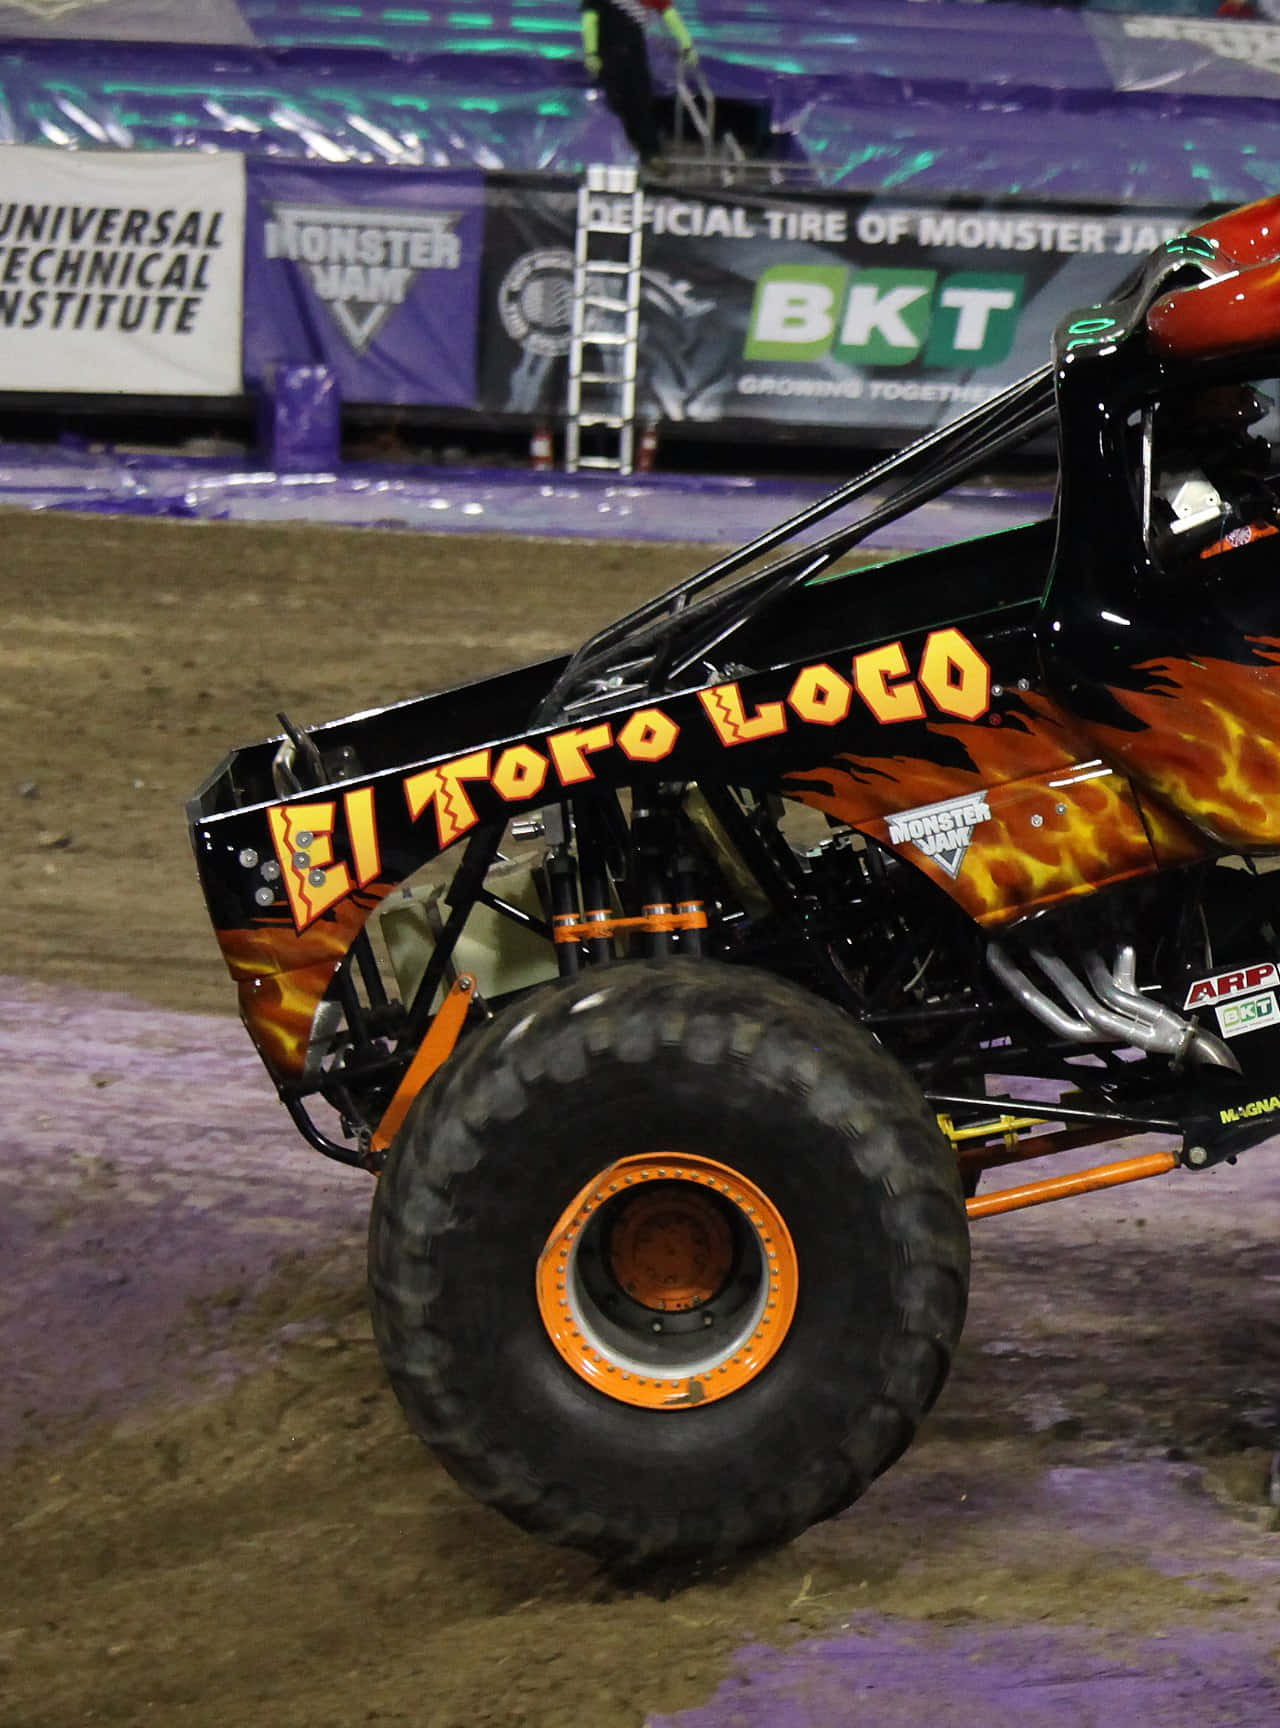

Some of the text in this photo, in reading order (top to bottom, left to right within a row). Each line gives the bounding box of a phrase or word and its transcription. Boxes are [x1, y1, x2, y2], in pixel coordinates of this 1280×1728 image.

[265, 222, 461, 269] MONSTER
[765, 210, 847, 242] TIRE
[857, 213, 909, 245] OF
[919, 216, 1105, 253] MONSTER
[0, 247, 210, 291] ECHNICAL
[309, 265, 412, 303] JAM
[0, 289, 202, 334] NSTITUTE
[752, 276, 1014, 352] BKT
[888, 799, 992, 846] MONSTER
[917, 825, 974, 857] JAM
[1188, 964, 1275, 1004] ARP
[1224, 997, 1273, 1026] BKT
